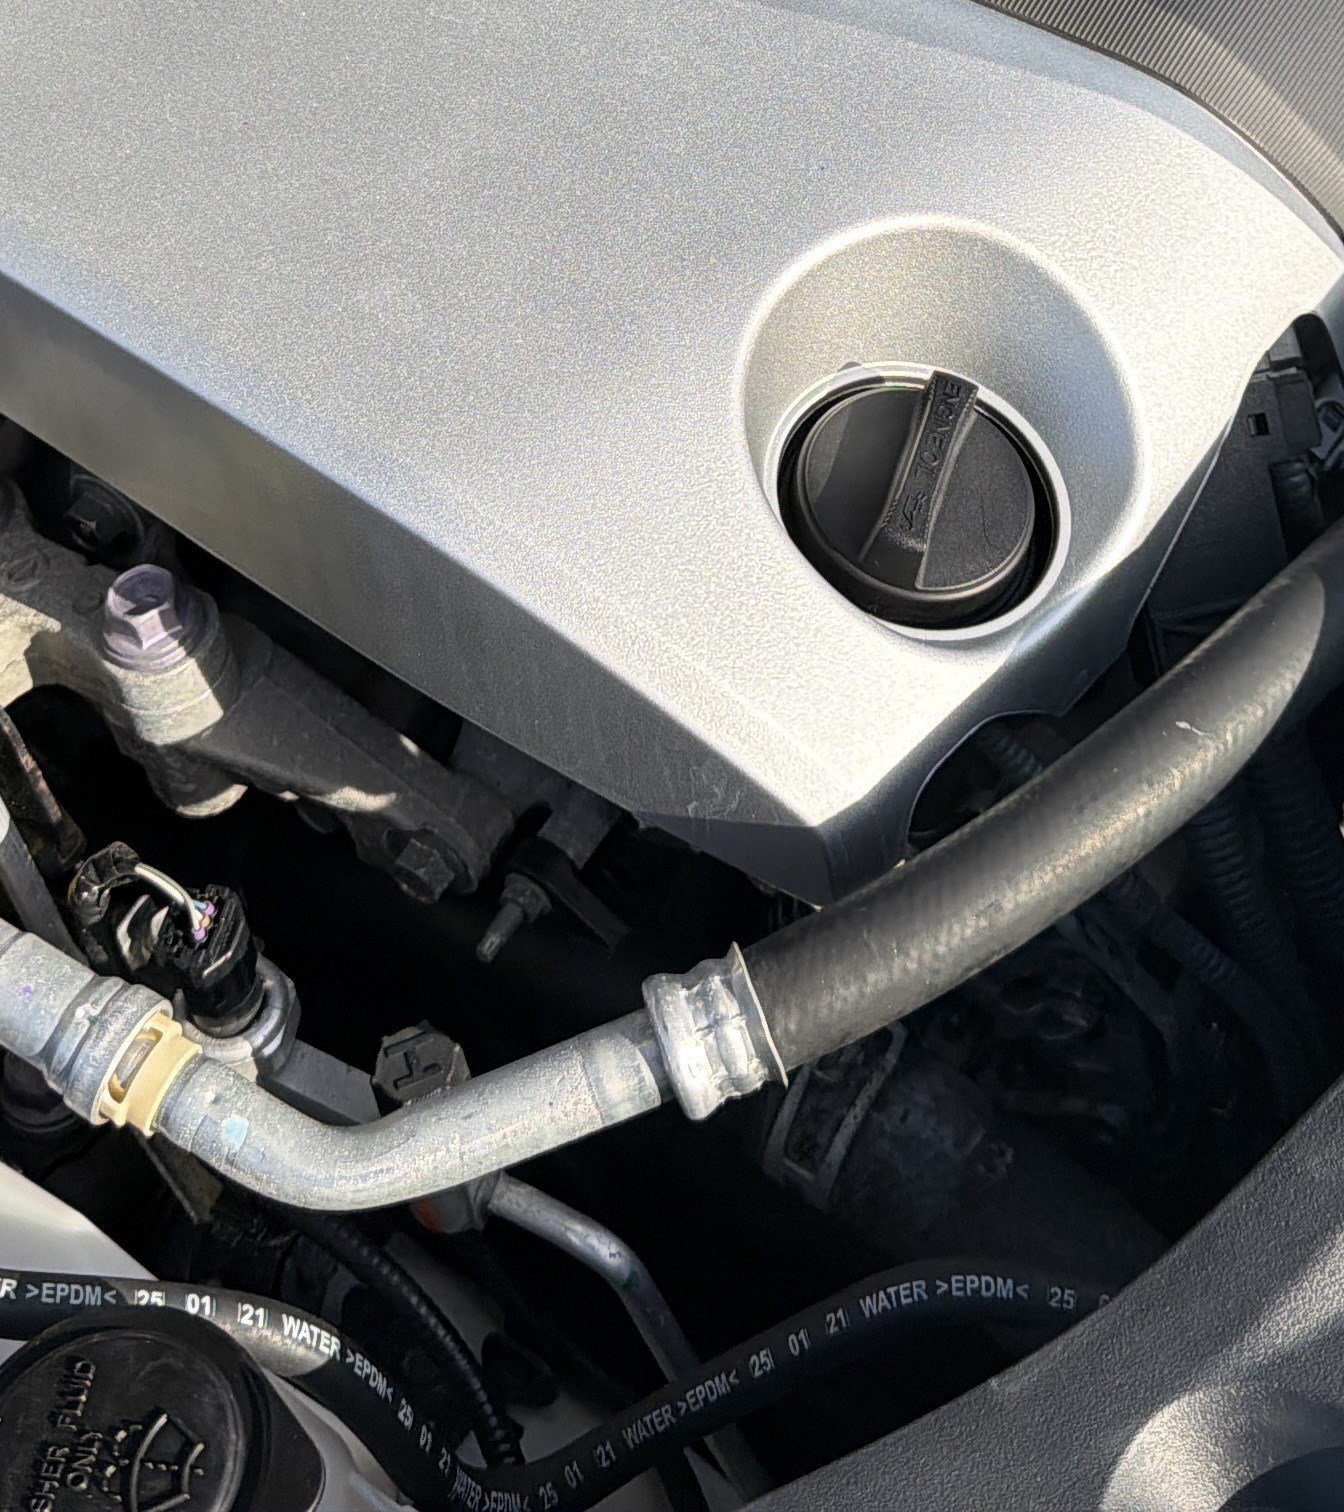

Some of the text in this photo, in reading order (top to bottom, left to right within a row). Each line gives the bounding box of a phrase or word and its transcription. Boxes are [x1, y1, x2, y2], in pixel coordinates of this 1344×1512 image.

[57, 1360, 96, 1432] FLUID
[281, 1313, 342, 1361] WATER
[621, 1404, 678, 1449] WATER
[858, 1279, 929, 1319] WATER
[66, 1431, 104, 1492] ONLY
